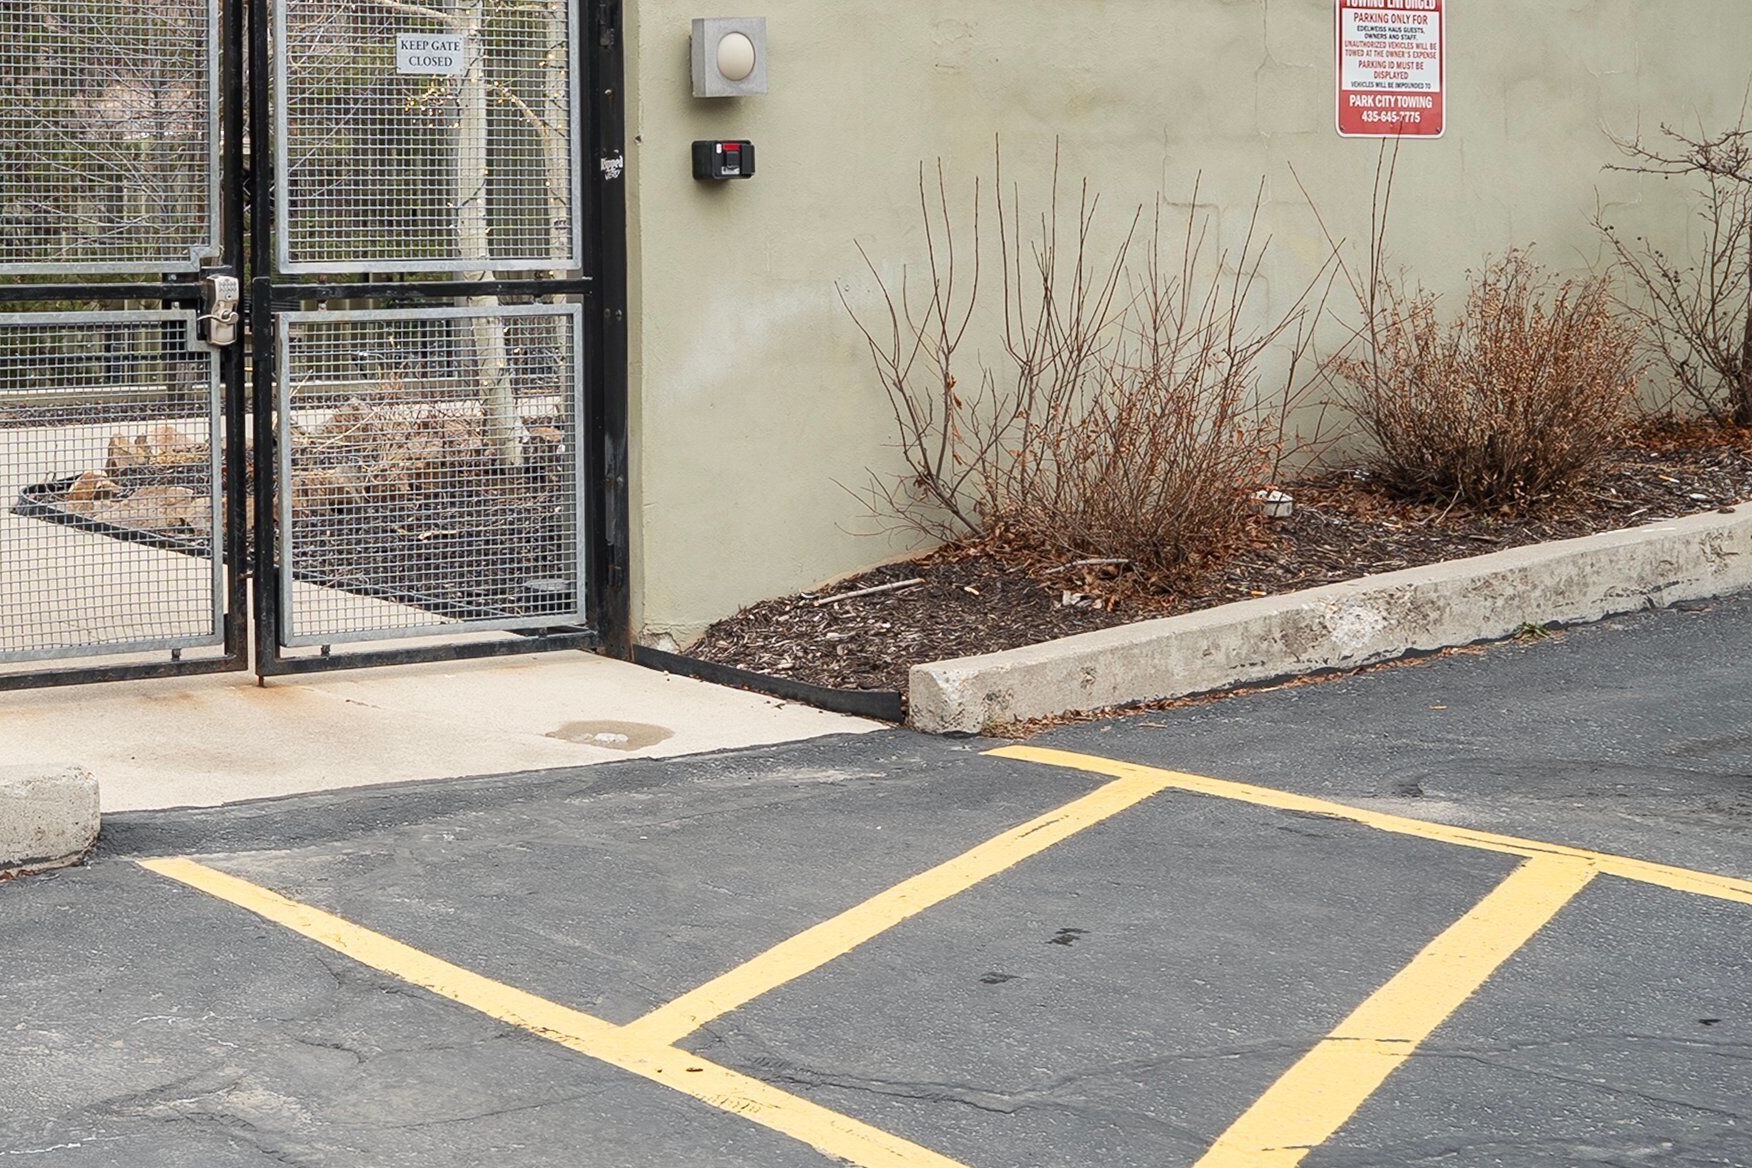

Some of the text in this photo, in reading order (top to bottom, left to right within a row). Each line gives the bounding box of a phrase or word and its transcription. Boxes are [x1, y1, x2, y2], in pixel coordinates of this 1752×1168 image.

[1353, 12, 1428, 25] PARKING ONLY FOR
[1403, 26, 1425, 34] GUESTS,
[401, 39, 461, 52] KEEP GATE
[1344, 40, 1437, 51] UNAUTHORIZED VEHICLES WILL BE
[1345, 49, 1364, 57] TOWED
[1374, 50, 1384, 58] THE
[1412, 51, 1437, 60] EXPENSE
[408, 56, 453, 67] CLOSED
[1358, 60, 1424, 70] PARKING ID MUST BE
[1373, 71, 1409, 80] DISPLAYED
[1375, 81, 1387, 89] WILL
[1425, 82, 1432, 90] TO
[1349, 95, 1433, 108] PARK CITY TOWING
[1361, 111, 1421, 123] 435-645-7775
